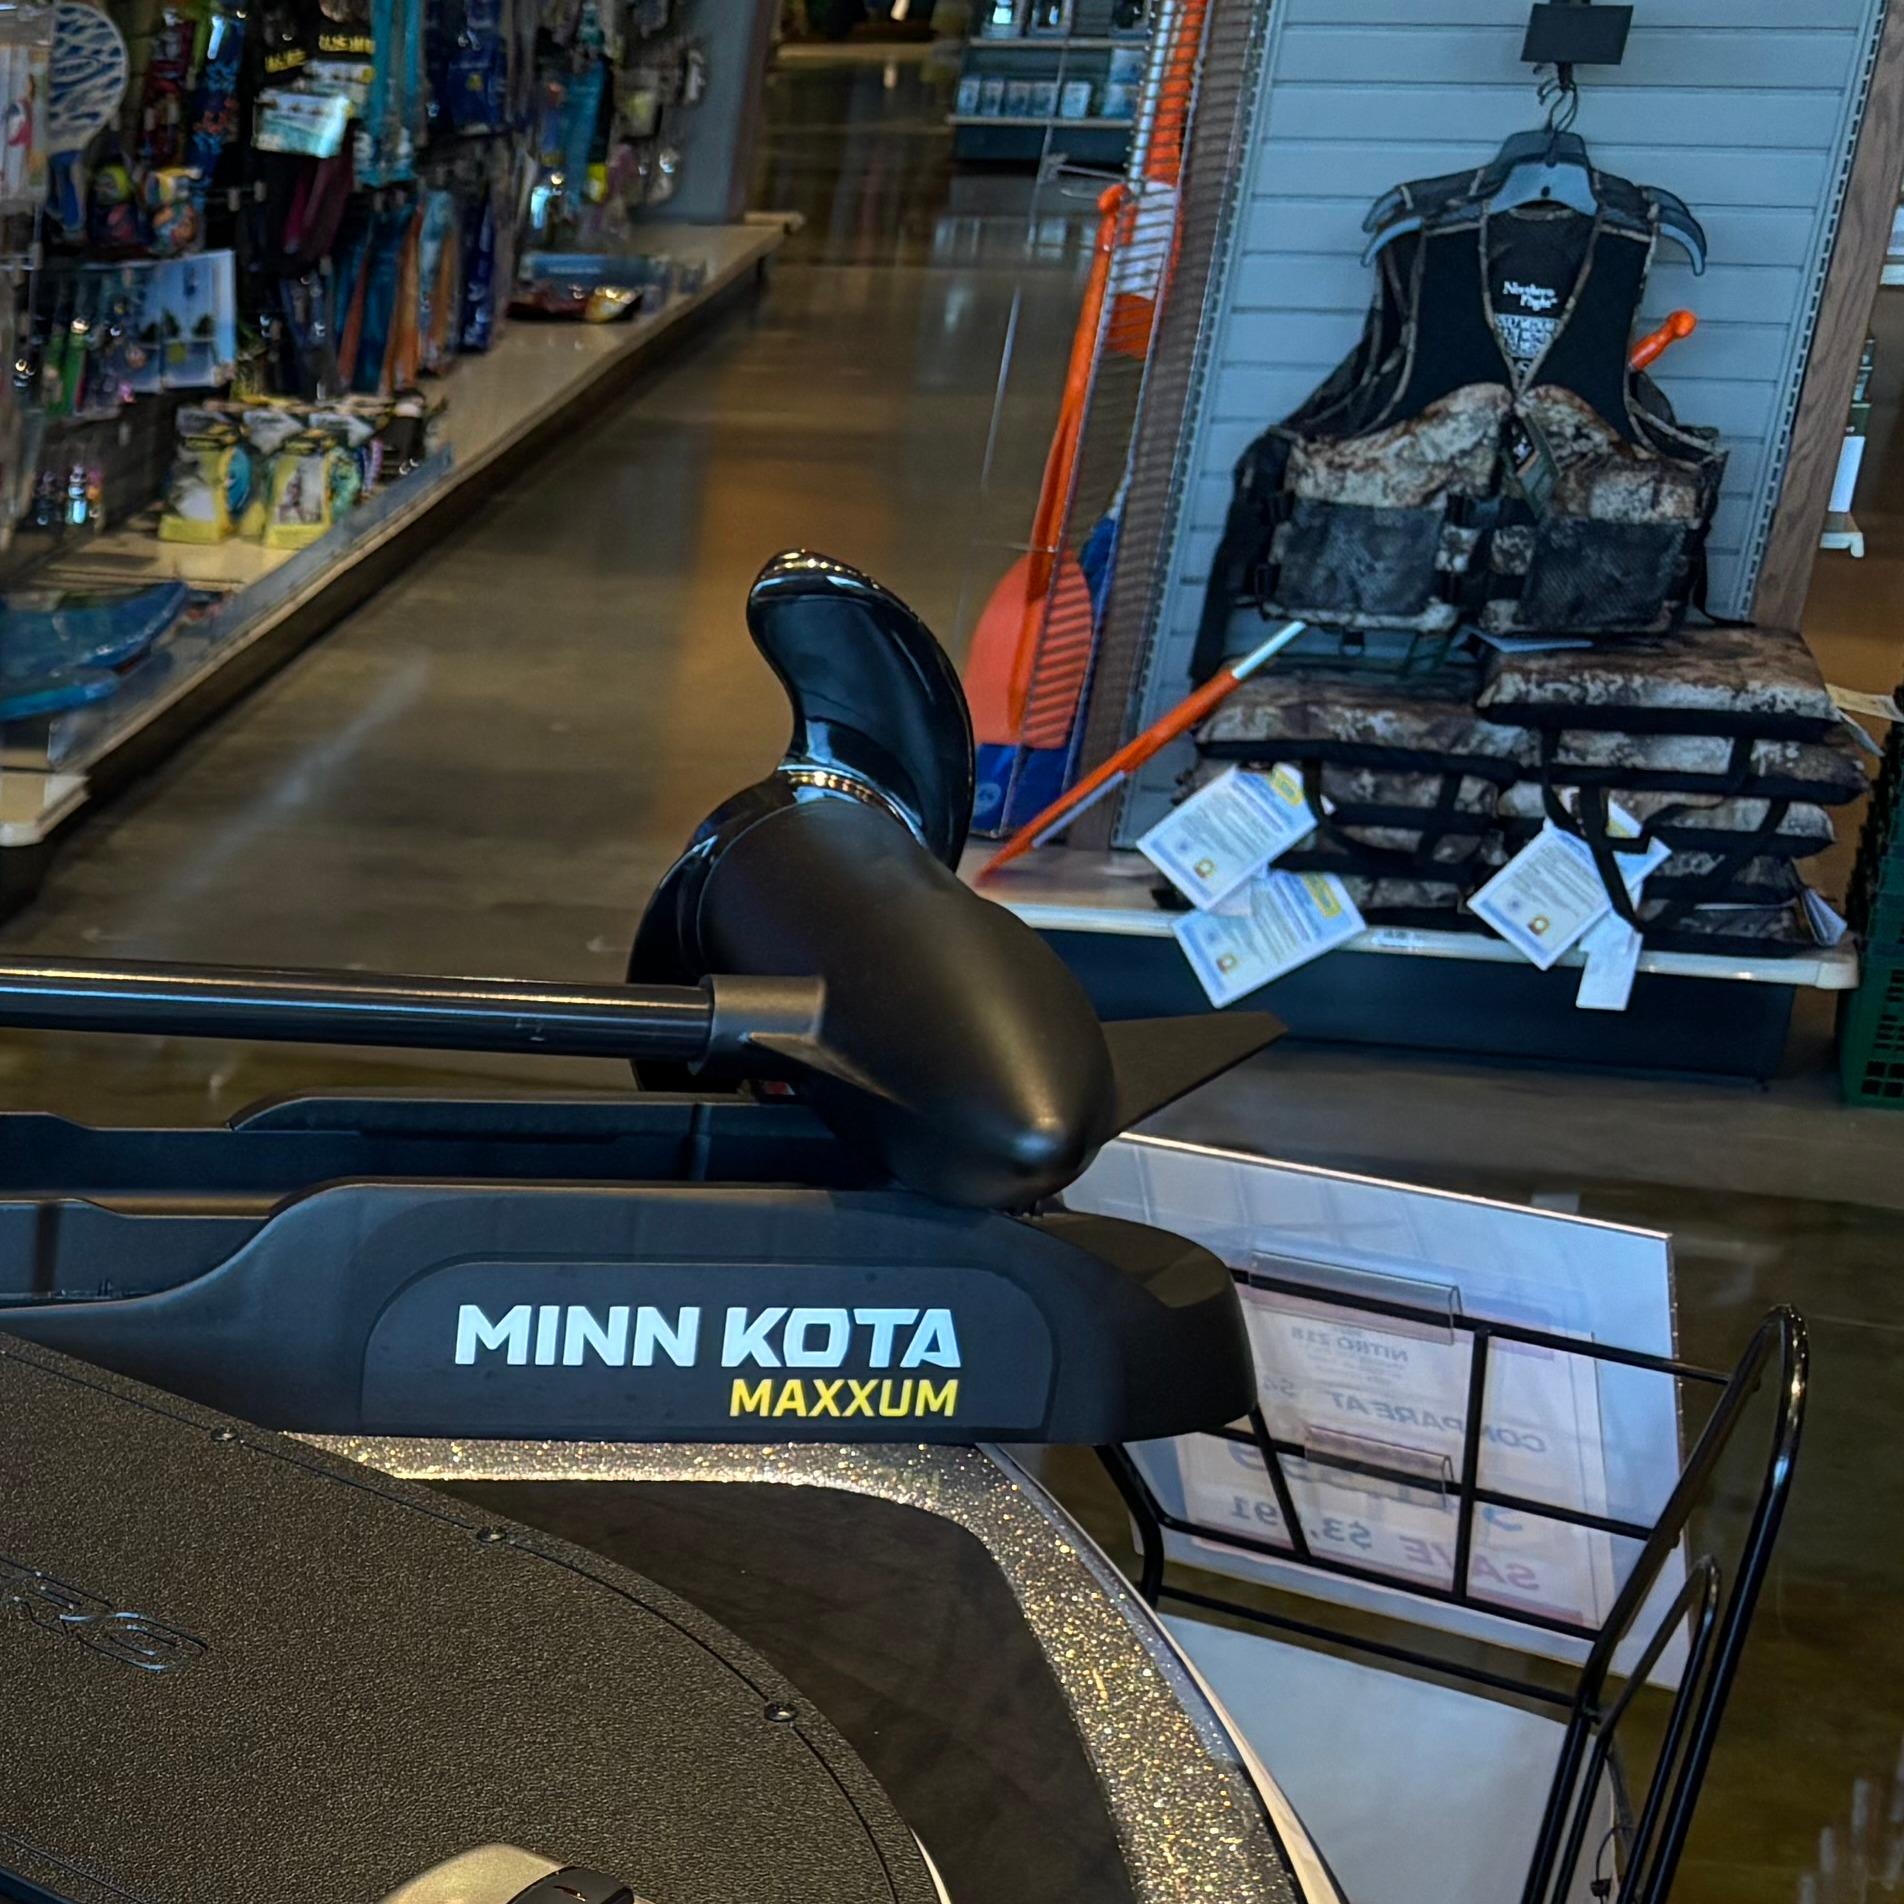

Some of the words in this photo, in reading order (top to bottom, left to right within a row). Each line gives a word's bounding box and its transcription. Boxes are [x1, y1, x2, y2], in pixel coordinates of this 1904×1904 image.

[455, 1304, 700, 1368] MINN
[721, 1306, 962, 1369] KOTA
[729, 1378, 960, 1418] MAXXUM
